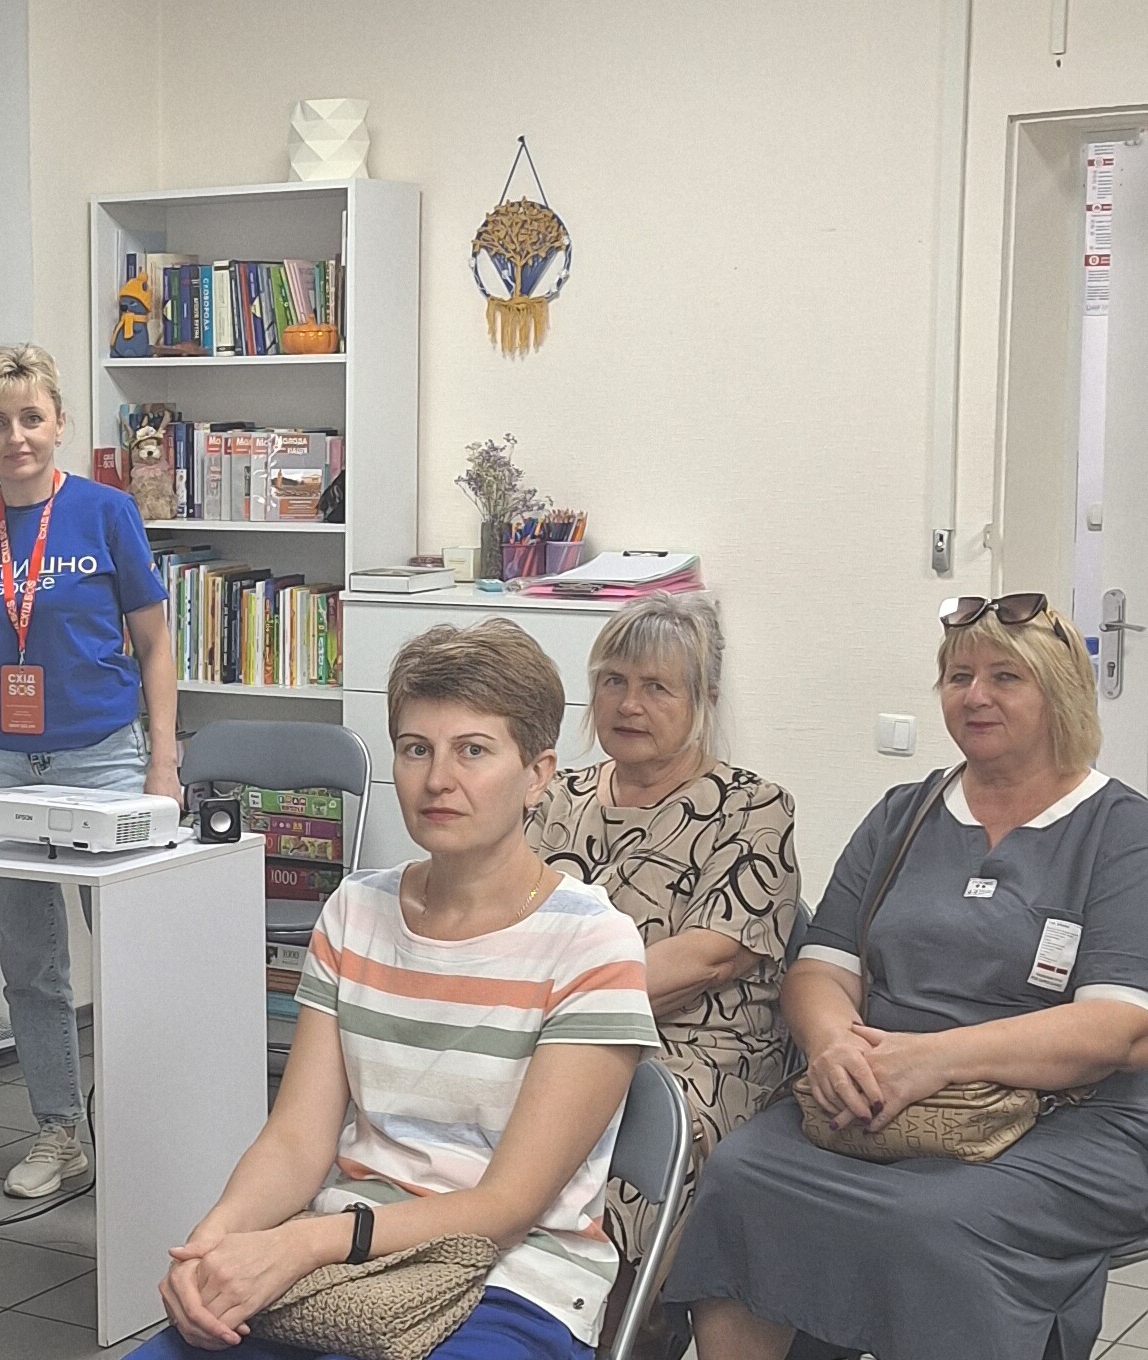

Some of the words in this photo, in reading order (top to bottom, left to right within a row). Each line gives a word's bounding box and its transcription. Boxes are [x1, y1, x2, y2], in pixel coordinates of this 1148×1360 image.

[8, 674, 35, 683] СХІД
[8, 684, 36, 696] SOS
[271, 869, 297, 886] 1000
